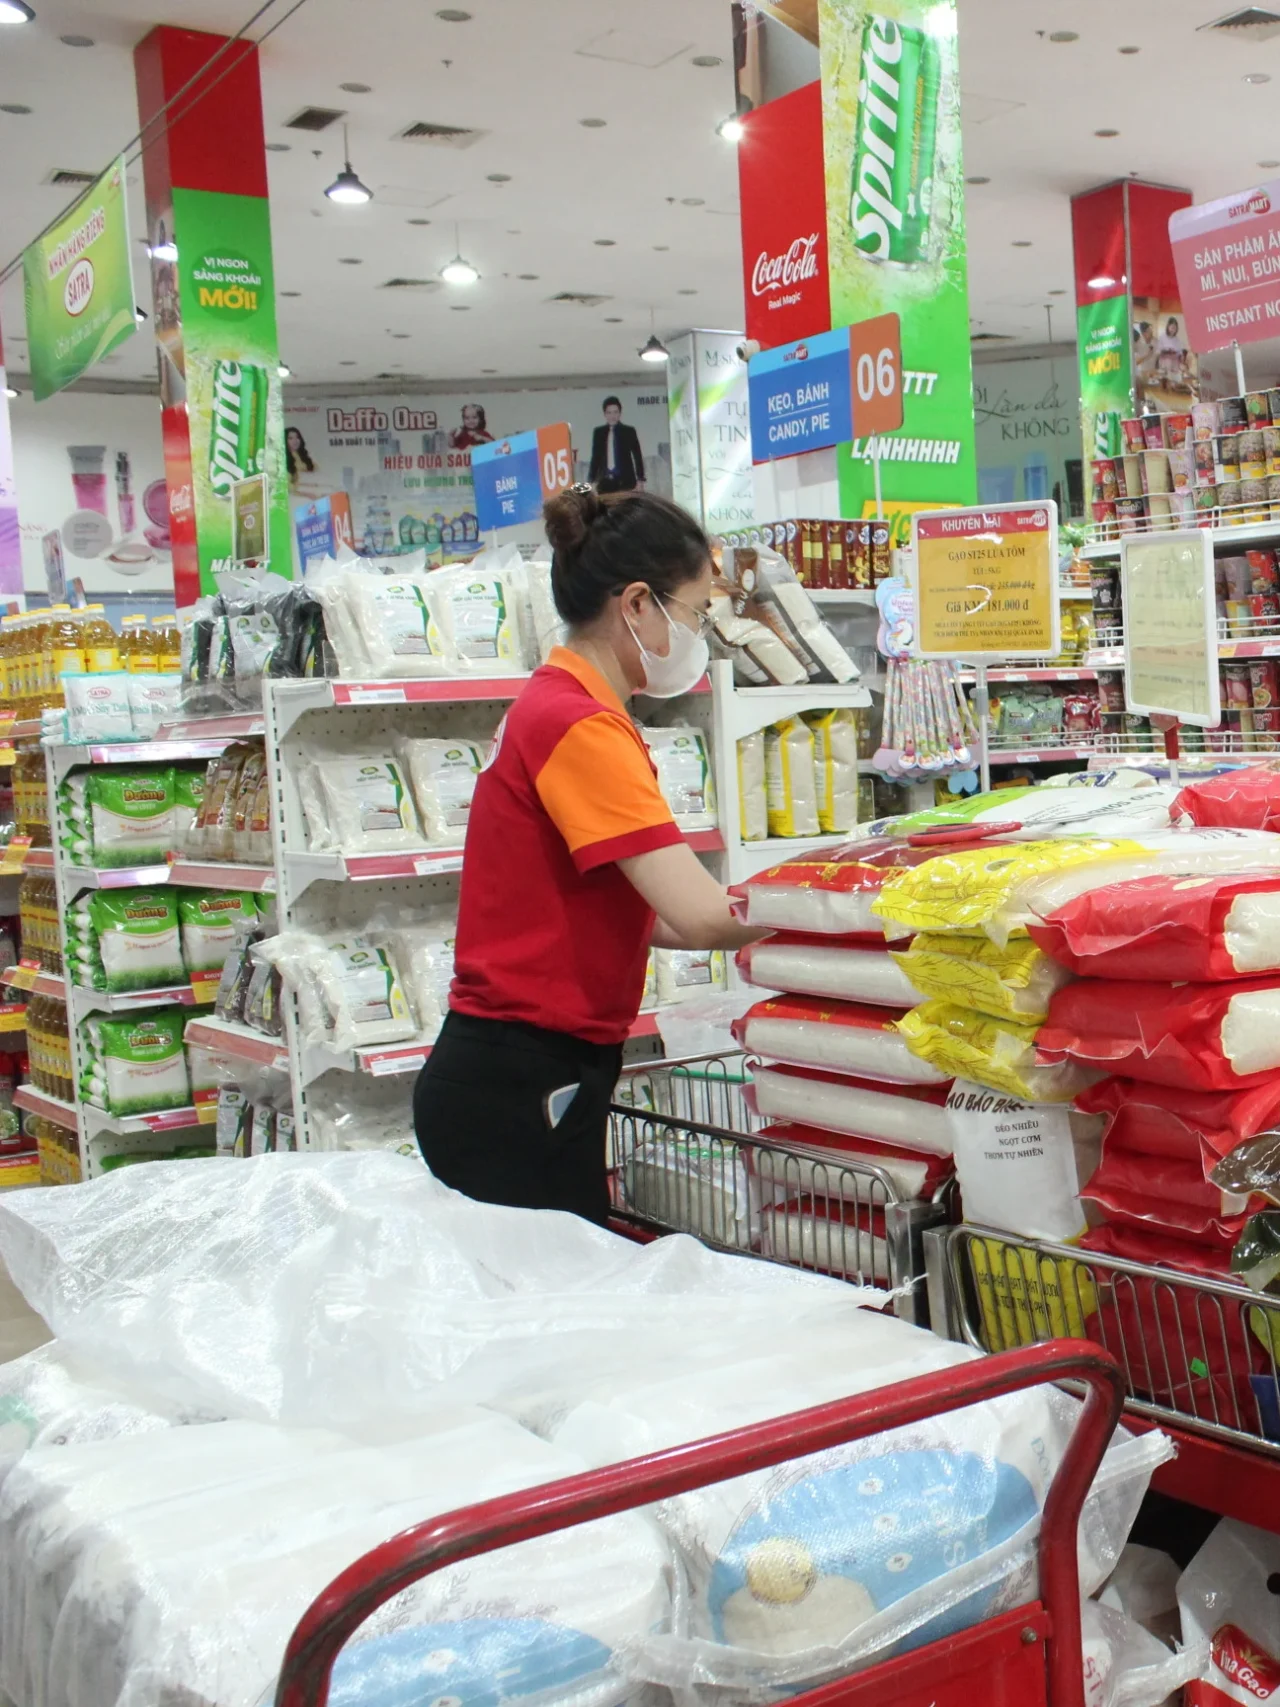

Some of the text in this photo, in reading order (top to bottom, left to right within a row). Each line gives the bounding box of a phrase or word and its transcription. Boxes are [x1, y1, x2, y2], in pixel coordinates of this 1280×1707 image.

[850, 14, 903, 259] Sprite
[215, 257, 249, 270] NGON
[1193, 246, 1223, 271] SẢN
[1224, 236, 1266, 261] PHẨM
[67, 271, 91, 308] SATRA
[1200, 272, 1221, 293] MÌ,
[1222, 267, 1251, 288] NUI,
[199, 284, 259, 311] MỚI!
[768, 291, 802, 310] Real Magic
[1205, 305, 1262, 332] INSTANT
[857, 347, 896, 402] 06
[637, 395, 660, 406] MADE
[768, 382, 830, 416] KẸO, BÁNH
[326, 405, 438, 434] Daffo One
[769, 411, 831, 442] CANDY, PIE
[1001, 417, 1071, 442] KHÔNG
[542, 448, 571, 491] 05
[495, 475, 519, 495] BÁNH
[501, 499, 515, 515] PIE
[946, 600, 962, 614] Giá
[987, 599, 1021, 611] 181.000
[124, 788, 166, 803] Đường
[125, 906, 169, 920] Đường
[1021, 1133, 1042, 1144] CƠM
[1017, 1146, 1045, 1159] NHIÊN
